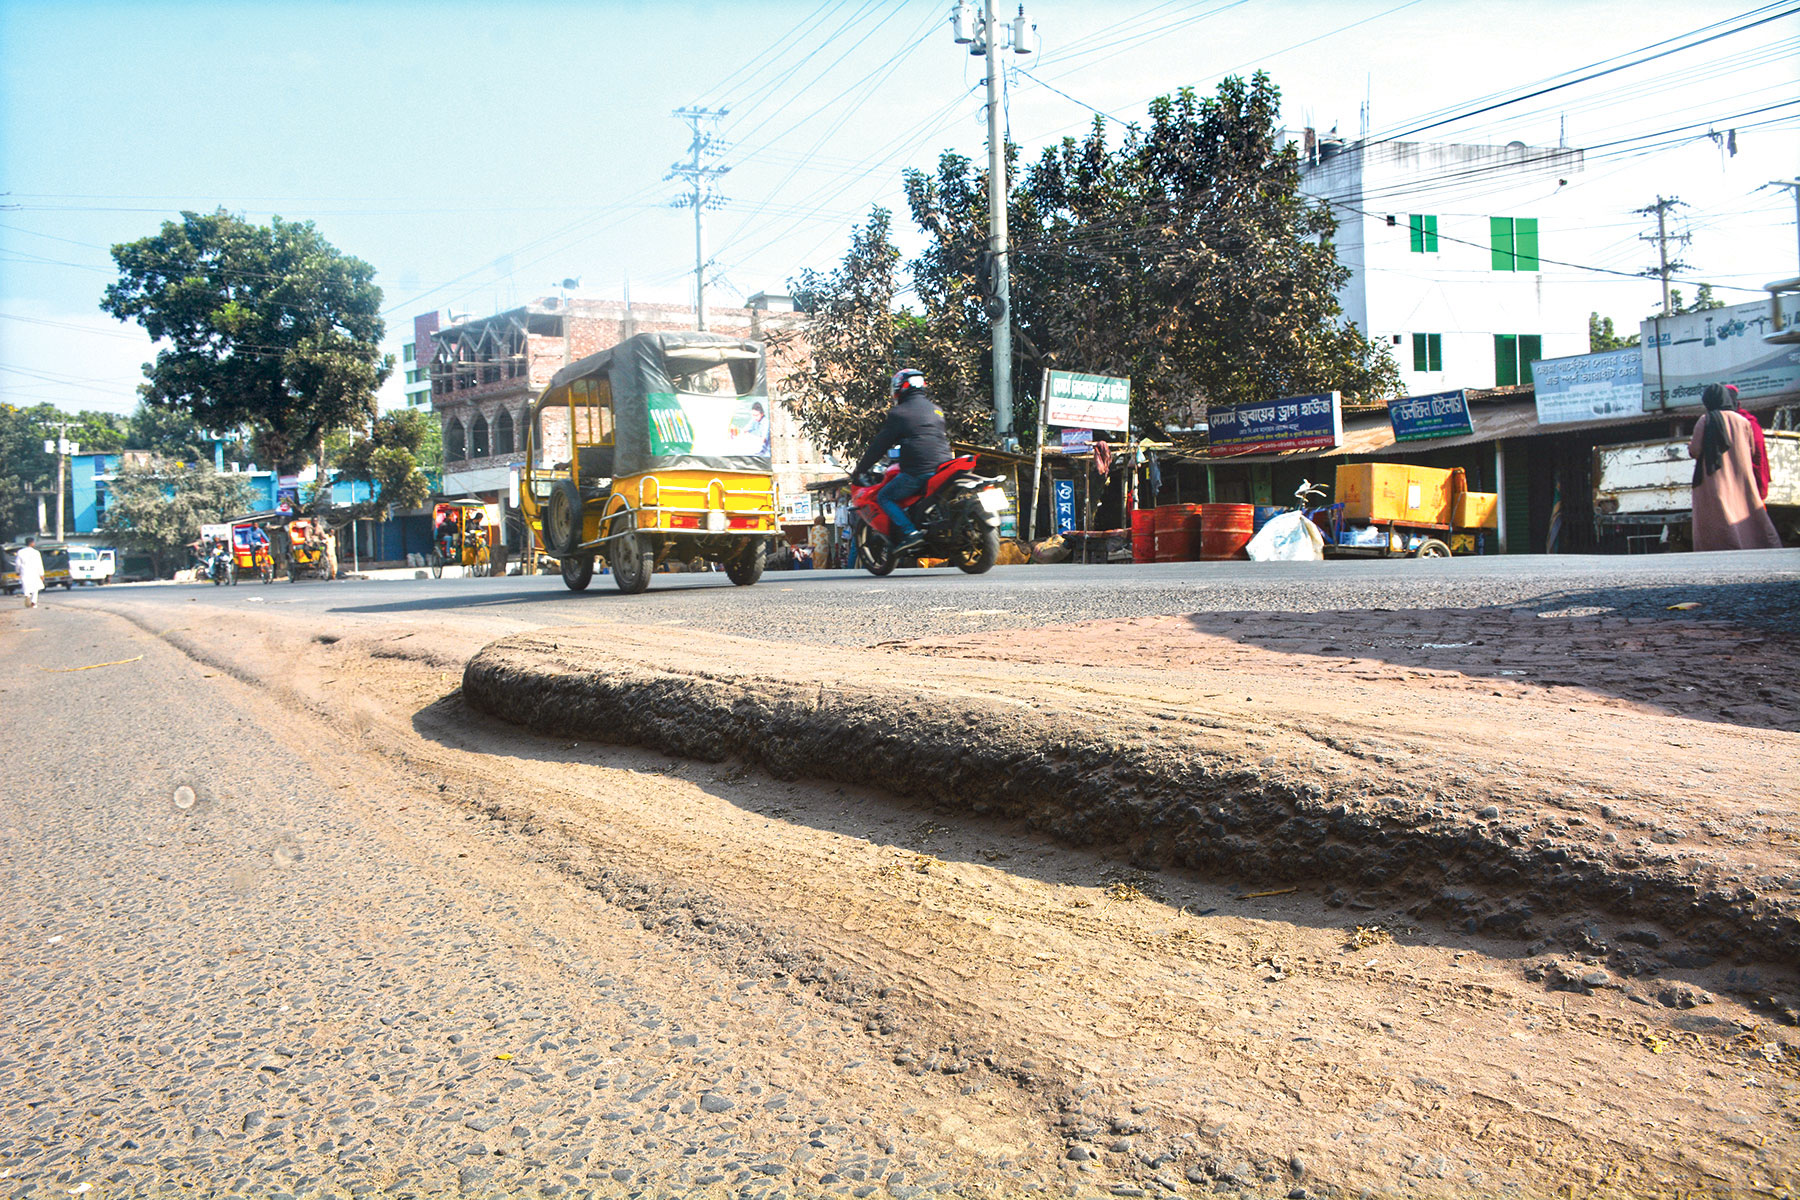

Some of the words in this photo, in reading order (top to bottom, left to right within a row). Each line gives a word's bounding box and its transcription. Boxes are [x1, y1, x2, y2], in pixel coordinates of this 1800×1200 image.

[1210, 407, 1236, 428] মেসার্স
[1238, 406, 1276, 426] জুবায়ের
[1278, 403, 1298, 422] ড্রাগ
[1300, 398, 1331, 416] হাউজ
[1399, 400, 1432, 420] ডলফিন
[1432, 392, 1463, 416] টেইলার্স
